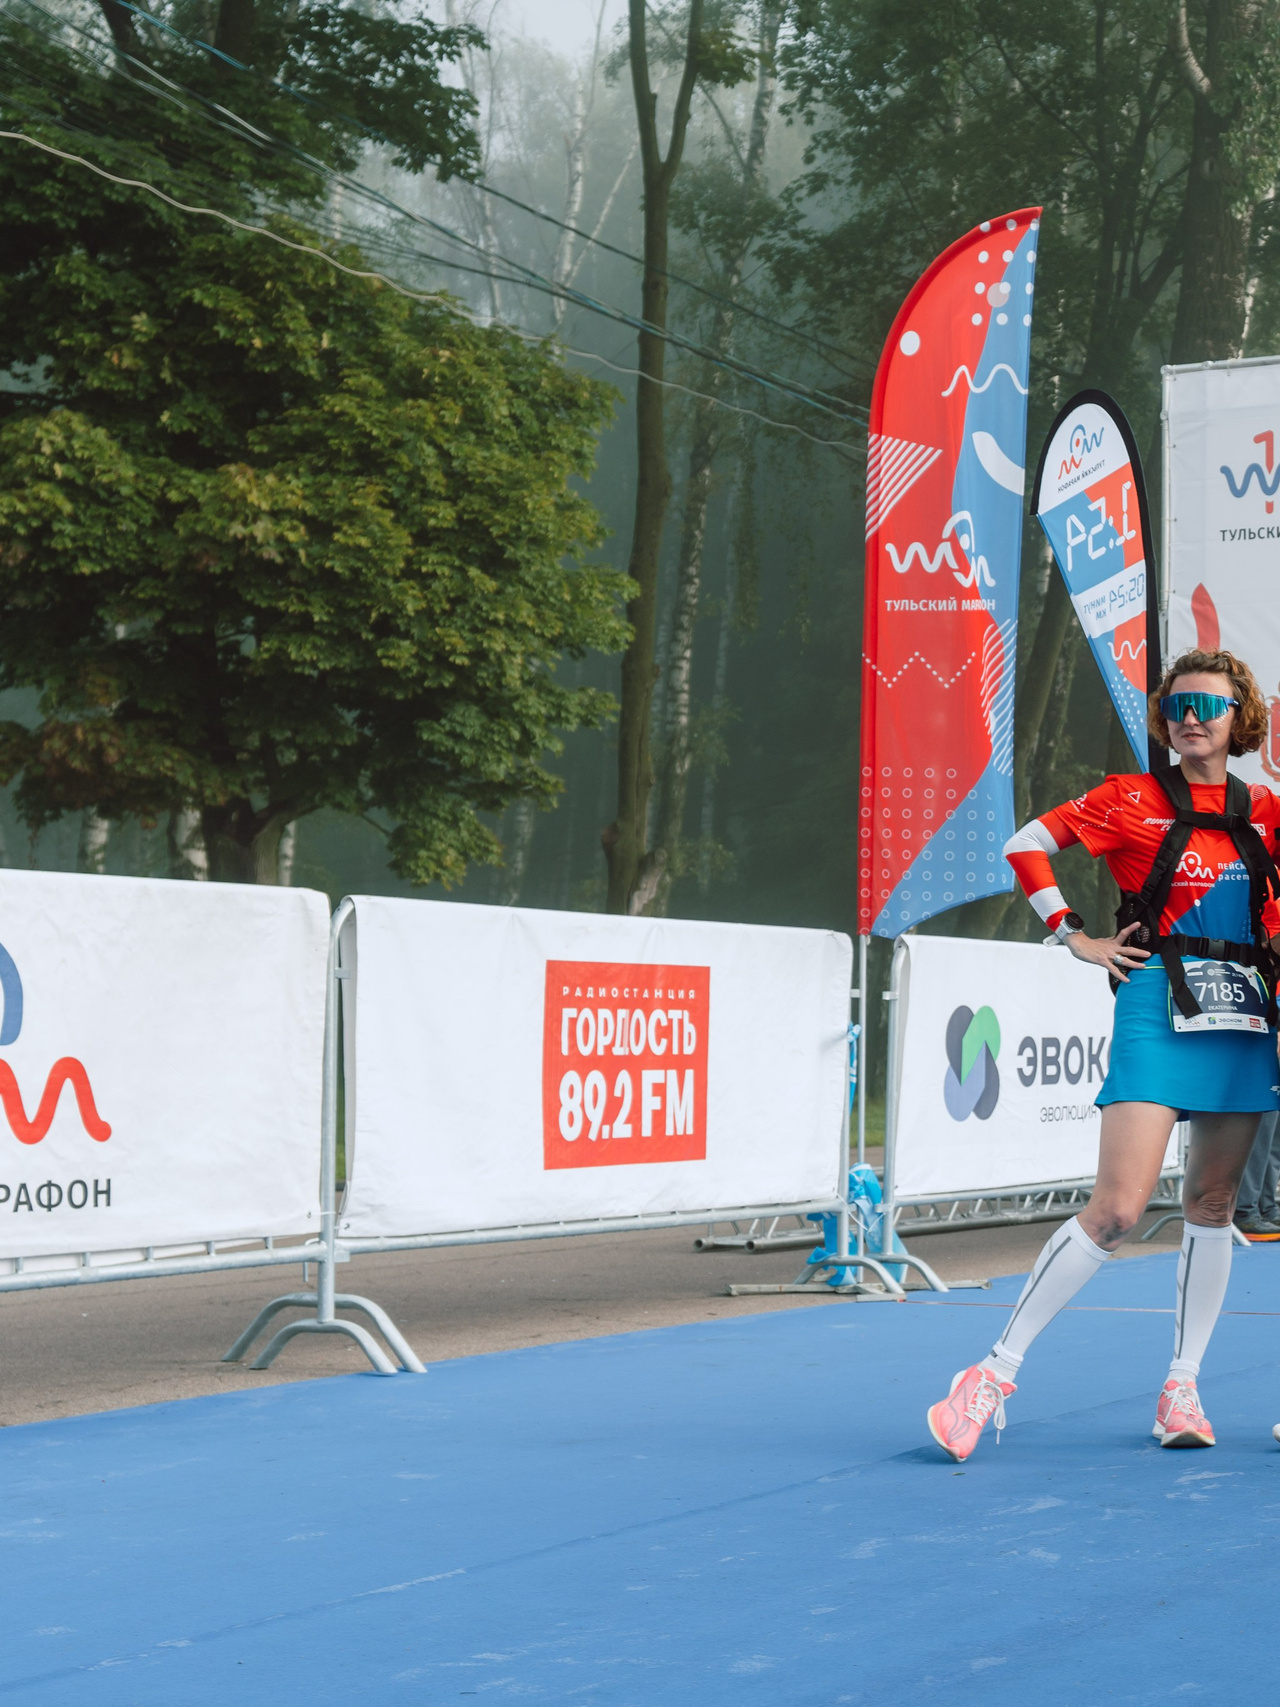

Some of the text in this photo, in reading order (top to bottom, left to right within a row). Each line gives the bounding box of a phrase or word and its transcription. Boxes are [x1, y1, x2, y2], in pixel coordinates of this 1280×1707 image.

[885, 597, 957, 611] ТУЛЬСКИЙ
[1217, 860, 1247, 871] ПЕЙСМ
[1218, 873, 1250, 882] pacem
[562, 986, 695, 1000] РАДИОСТАНЦИЯ
[1194, 982, 1245, 1003] 7185
[561, 1007, 696, 1056] ГОРДОСТЬ
[1016, 1035, 1112, 1087] ЭВОК
[559, 1069, 694, 1141] 89.2 FM
